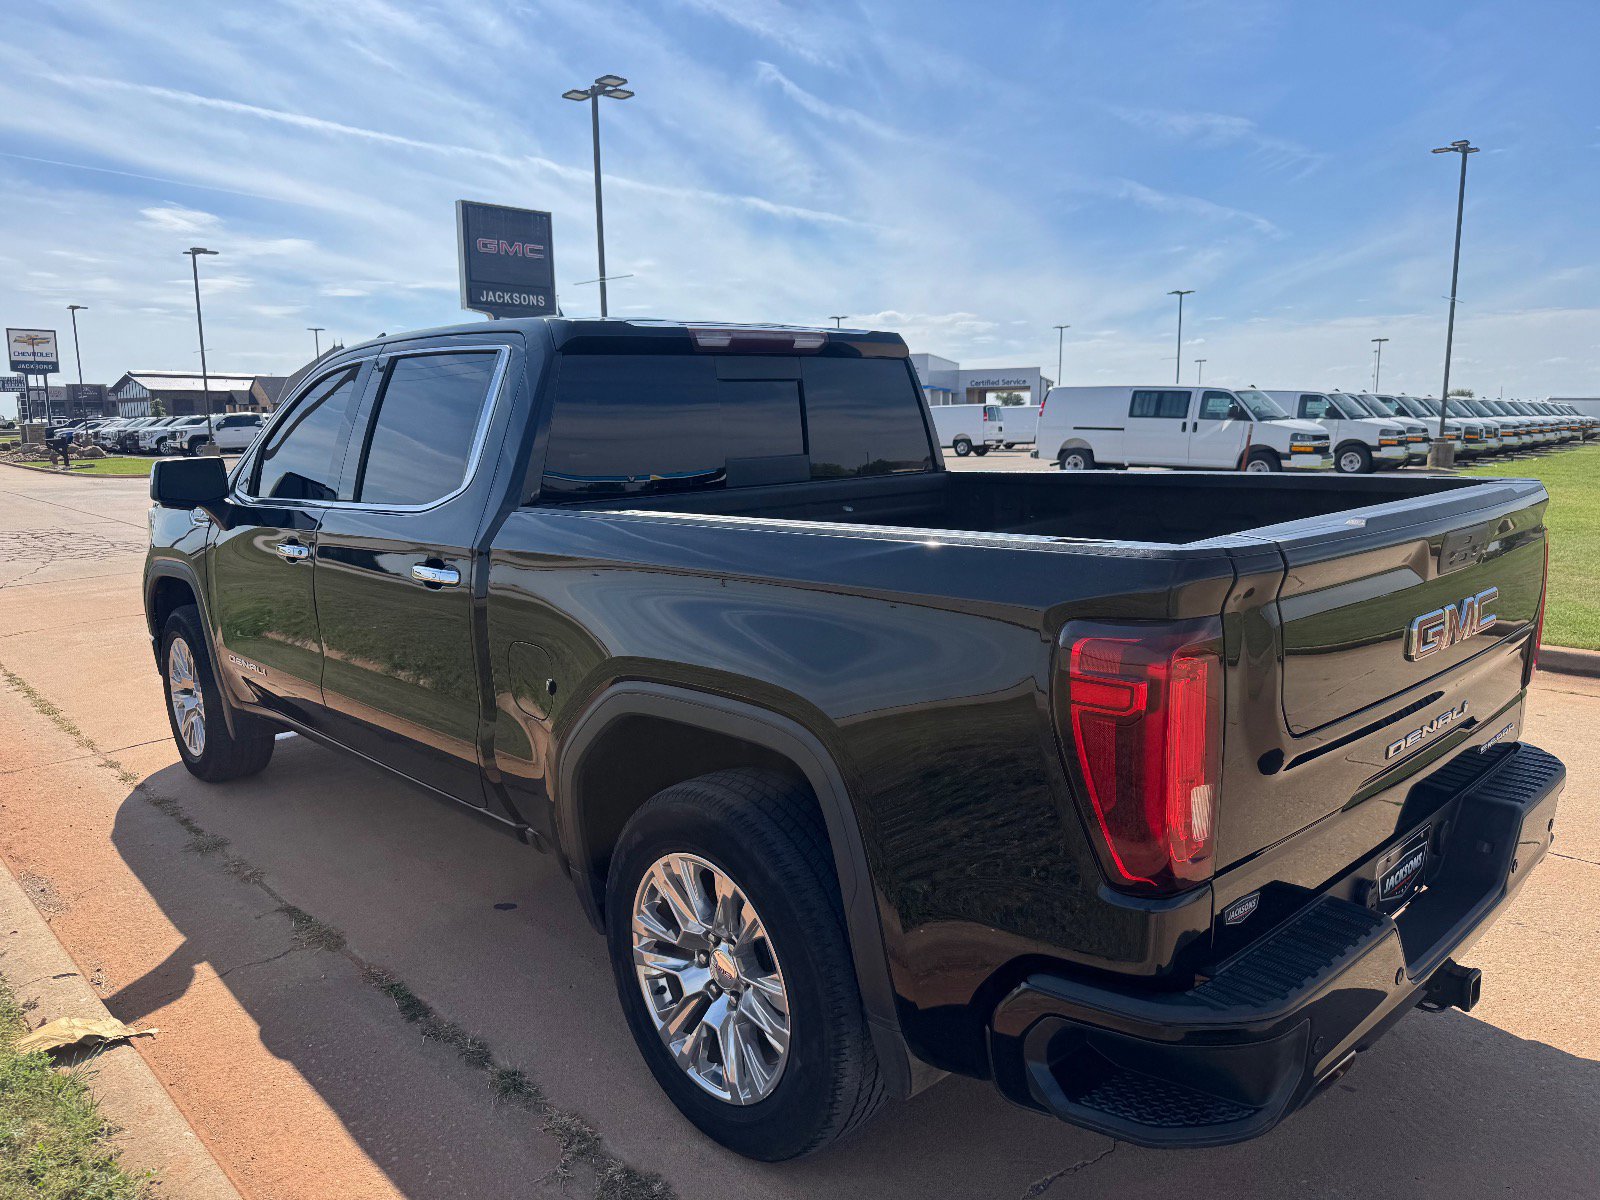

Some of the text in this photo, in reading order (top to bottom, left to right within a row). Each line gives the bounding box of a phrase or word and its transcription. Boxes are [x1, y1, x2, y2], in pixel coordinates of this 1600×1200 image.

[476, 238, 545, 259] GMC
[480, 290, 545, 307] JACKSONS
[970, 378, 1027, 387] Certified Service
[1404, 586, 1499, 662] GMC
[228, 654, 268, 677] DENALI
[1384, 700, 1469, 760] DENALI
[1383, 851, 1423, 895] JACKSONS
[1227, 898, 1257, 921] JACKSONS
